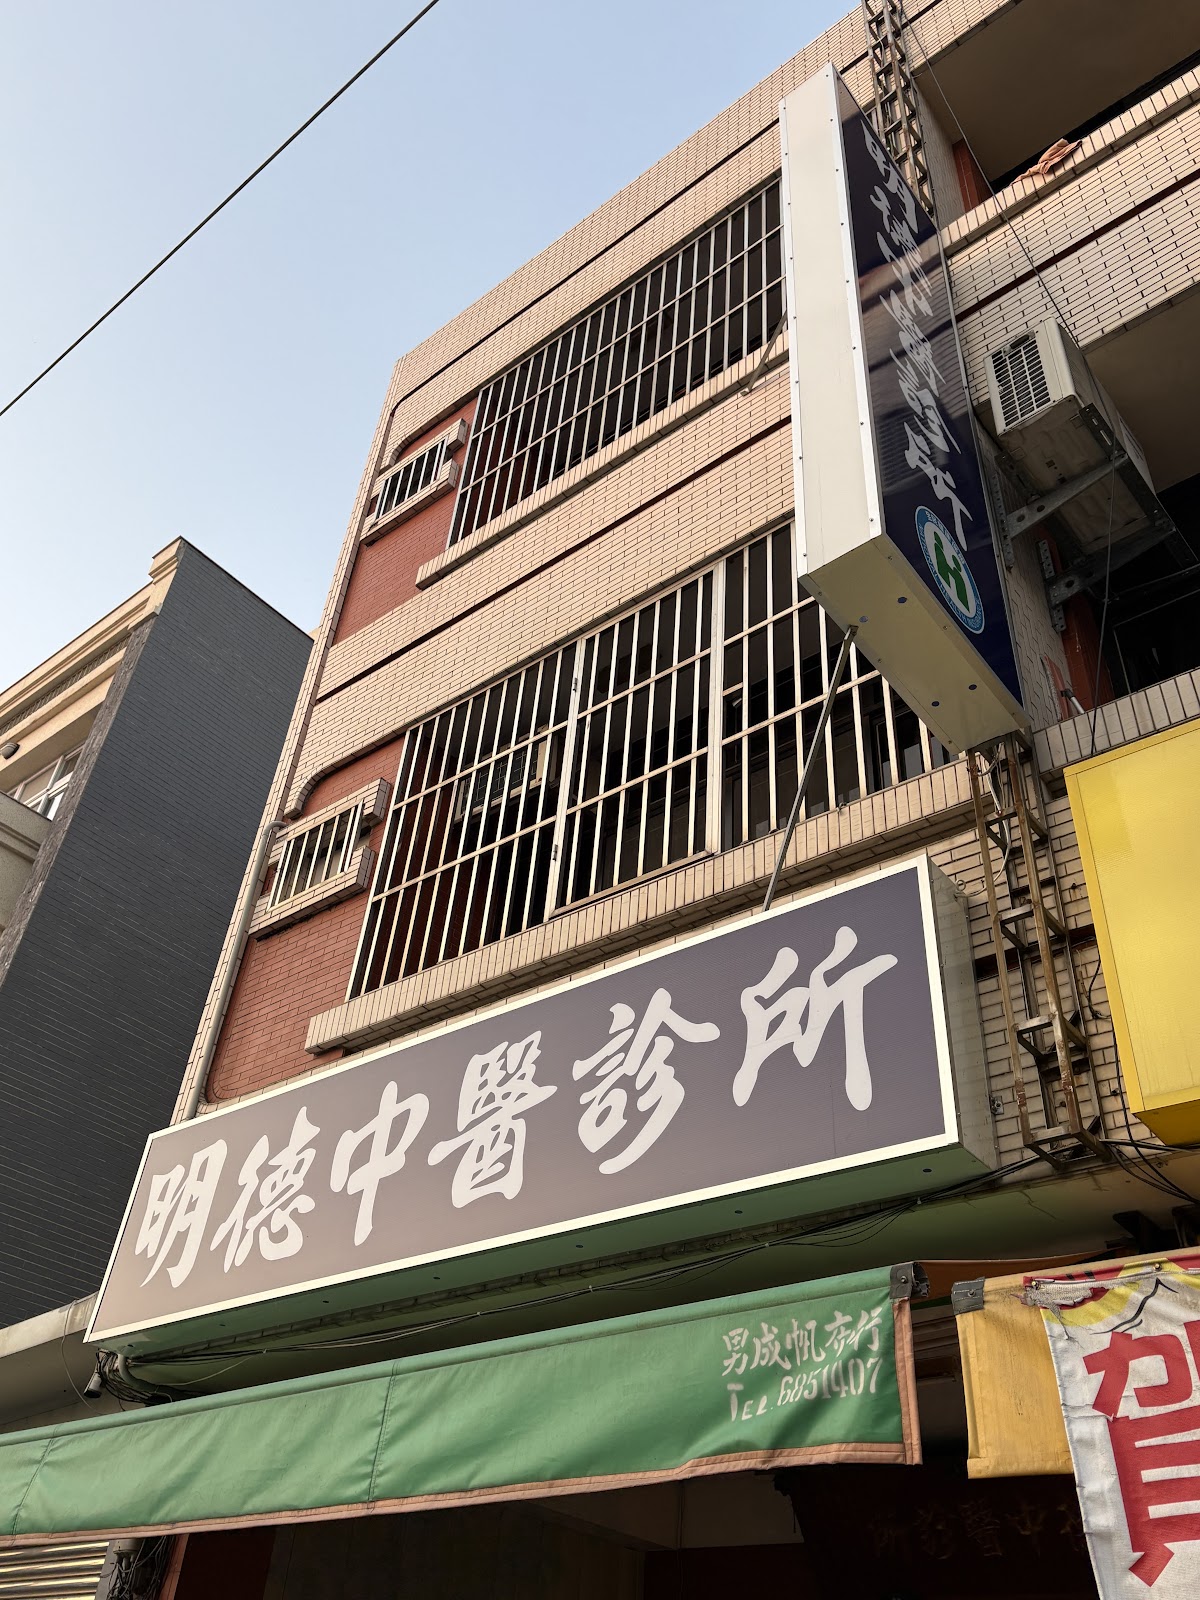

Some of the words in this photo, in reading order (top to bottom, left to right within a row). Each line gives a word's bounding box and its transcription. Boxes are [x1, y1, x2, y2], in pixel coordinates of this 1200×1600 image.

[860, 119, 973, 552] 明德中醫診所
[133, 926, 898, 1289] 明德中醫診所
[777, 1357, 883, 1407] 6851407
